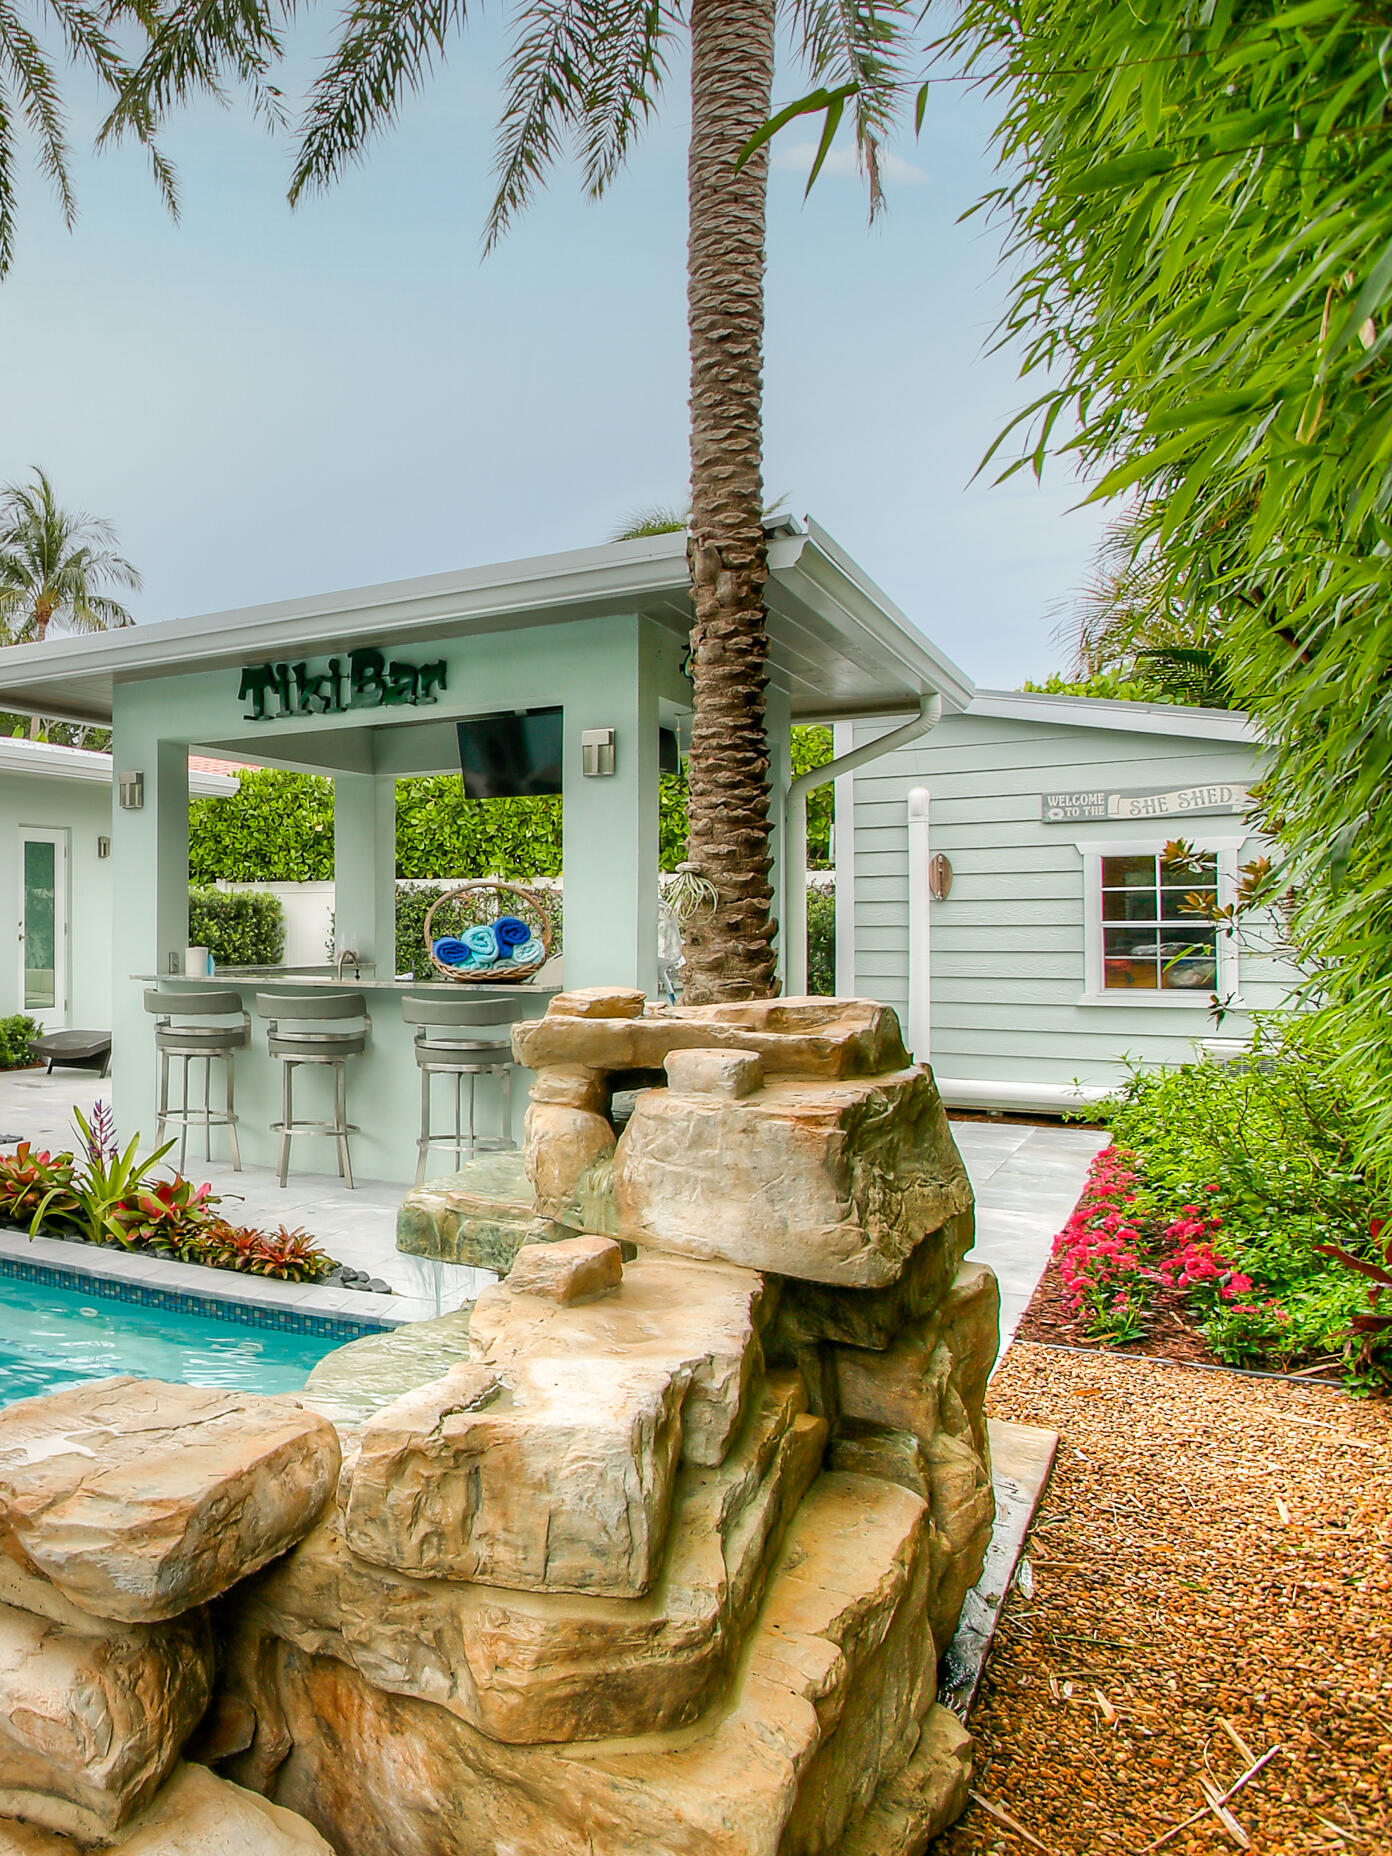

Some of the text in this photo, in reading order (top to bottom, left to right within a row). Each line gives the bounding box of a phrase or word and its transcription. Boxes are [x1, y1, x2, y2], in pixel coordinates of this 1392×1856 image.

[346, 648, 448, 709] Bar
[1047, 793, 1105, 807] WELCOME
[1129, 787, 1233, 816] SHE SHED
[1065, 805, 1105, 817] TO THE
